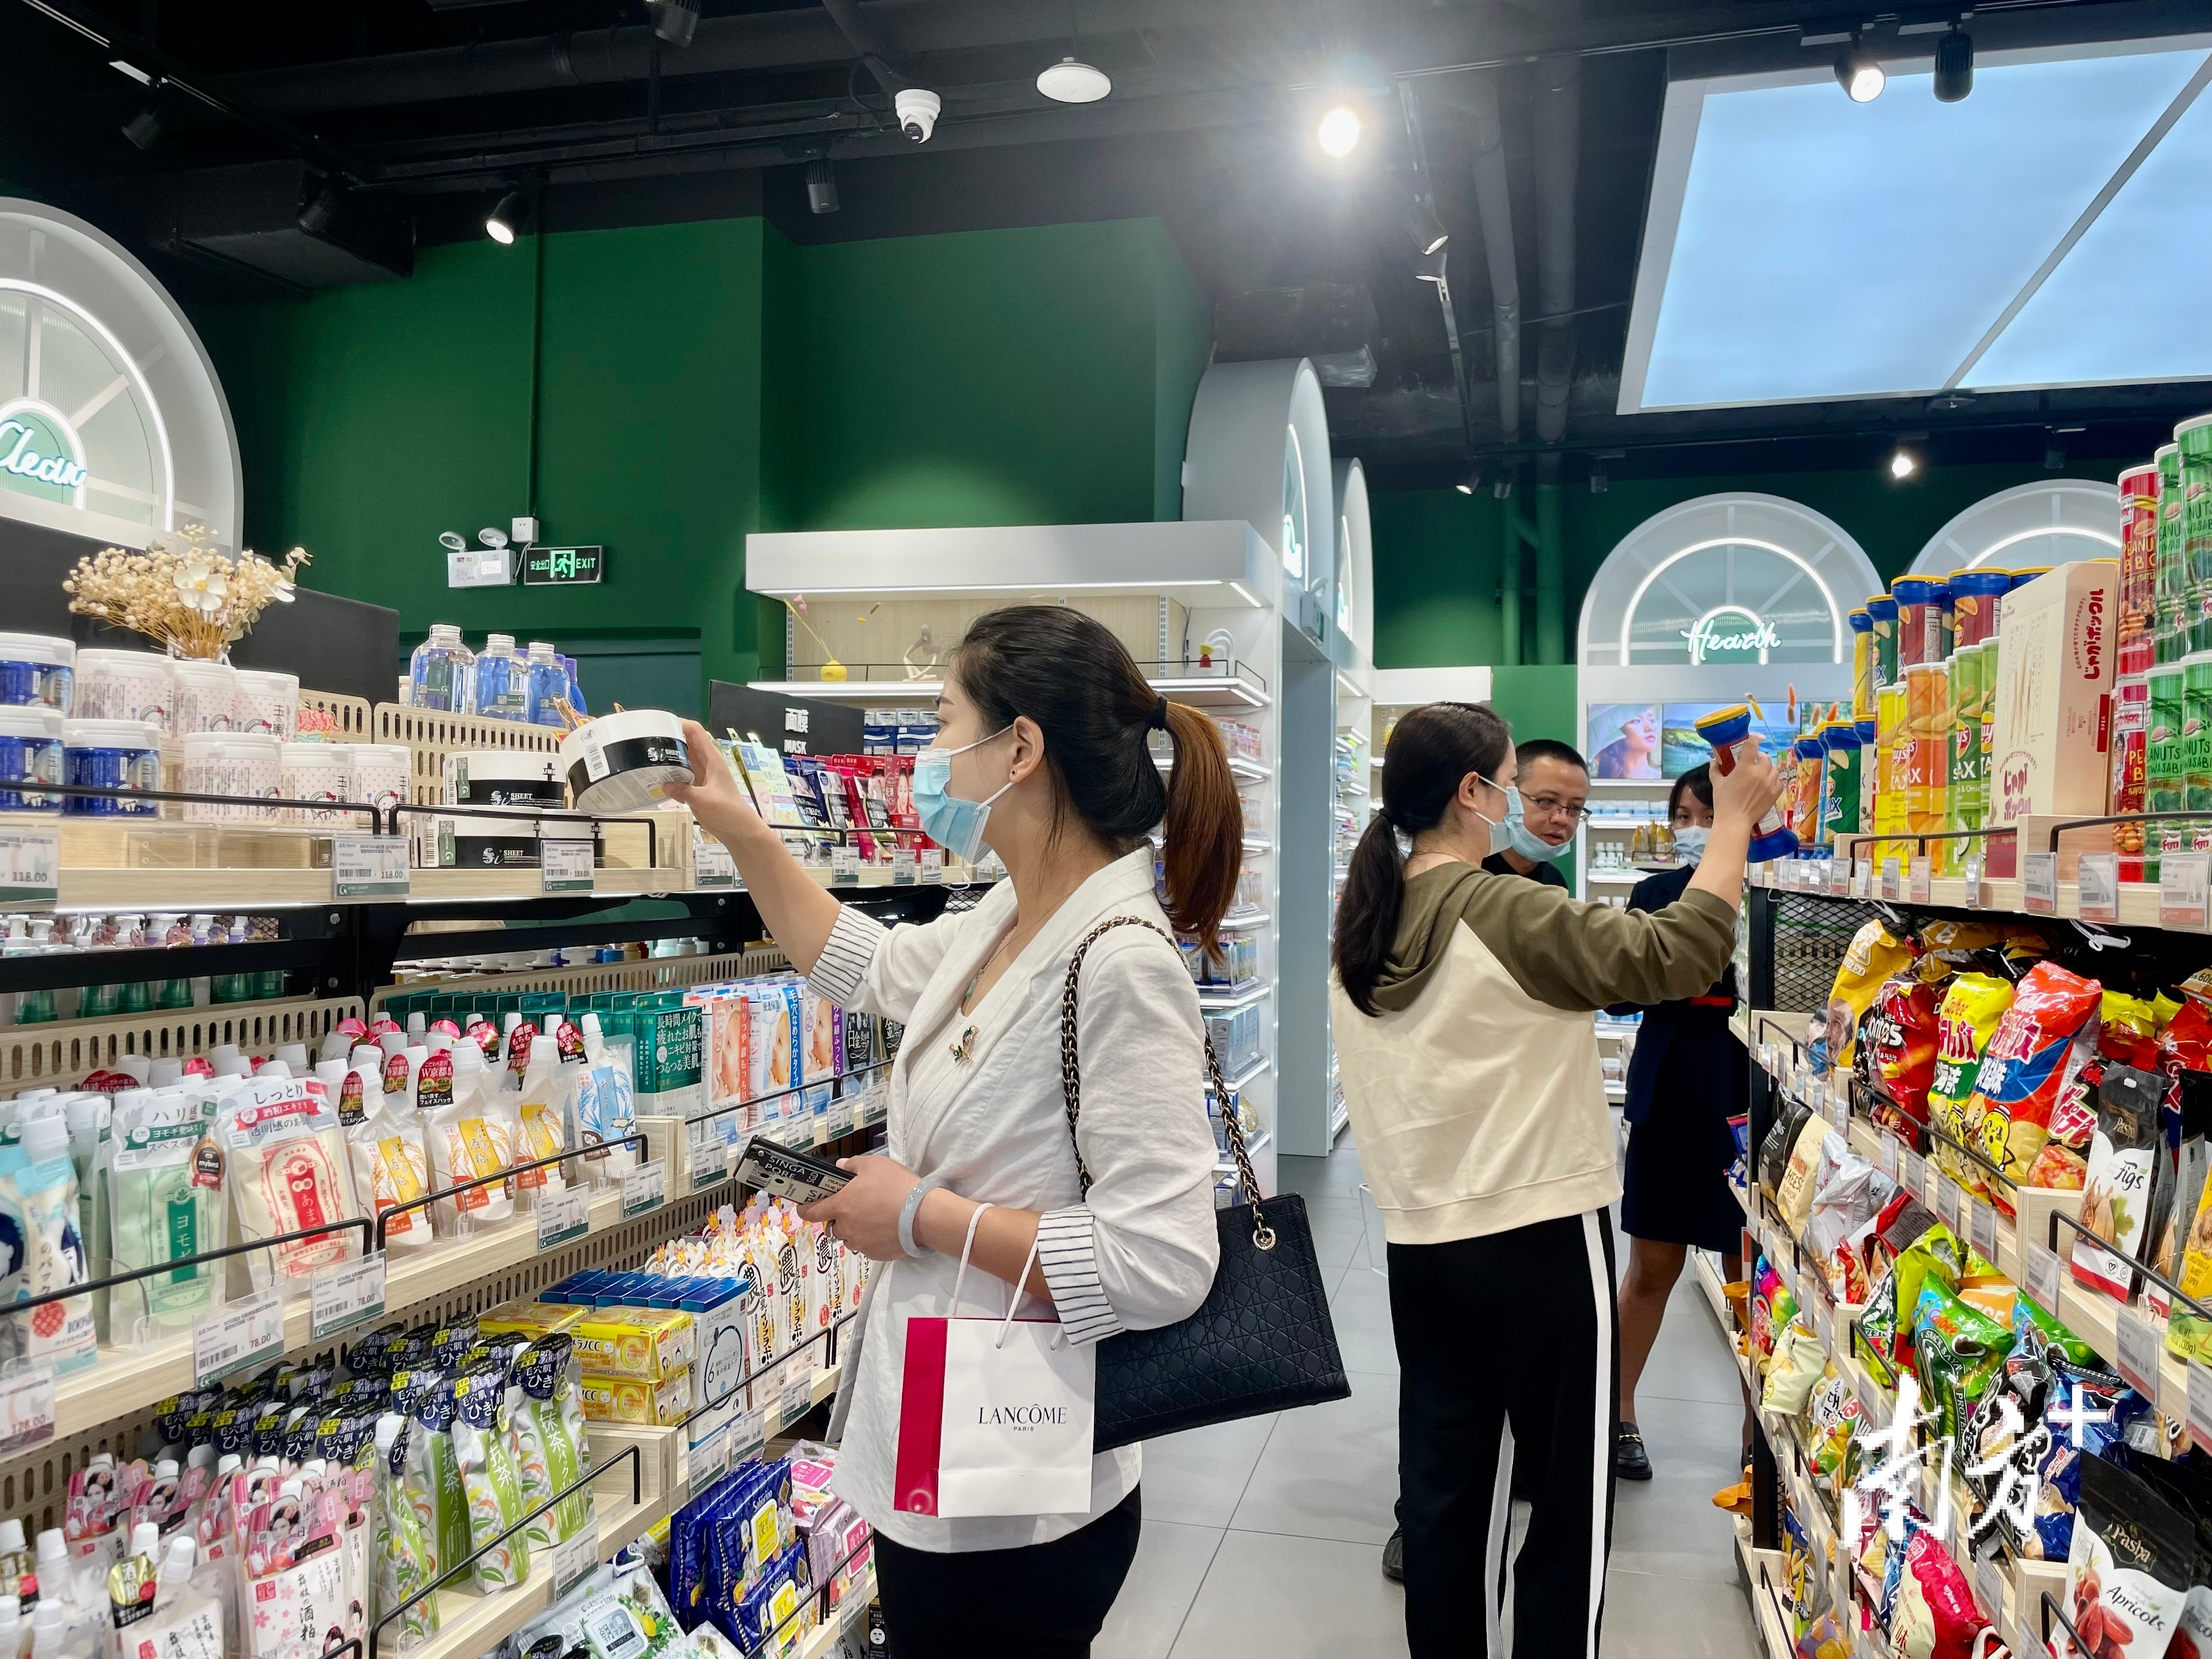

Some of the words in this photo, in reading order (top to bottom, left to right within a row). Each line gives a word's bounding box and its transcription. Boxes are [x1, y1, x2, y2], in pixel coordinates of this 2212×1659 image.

[576, 557, 596, 569] EXIT
[1680, 618, 1782, 662] Hearth
[2083, 588, 2104, 680] じゃがポックル
[785, 708, 809, 733] 面膜
[784, 740, 808, 755] MASK
[2004, 762, 2028, 797] じゃが
[12, 872, 48, 883] 118.00
[381, 871, 403, 879] 118.00
[657, 1011, 702, 1029] 長時間メイクで
[657, 1024, 702, 1046] 疲れたお肌も
[768, 1156, 805, 1176] SINGA
[2114, 1160, 2146, 1191] Figs
[357, 1293, 375, 1307] 78.00
[249, 1333, 272, 1350] 78.00
[397, 1386, 425, 1401] 毛穴肌
[461, 1389, 487, 1406] 毛穴肌
[978, 1403, 1068, 1425] LANCÔME
[323, 1432, 354, 1446] 毛穴肌
[2111, 1523, 2151, 1564] Pasha
[2105, 1585, 2166, 1632] Apricots
